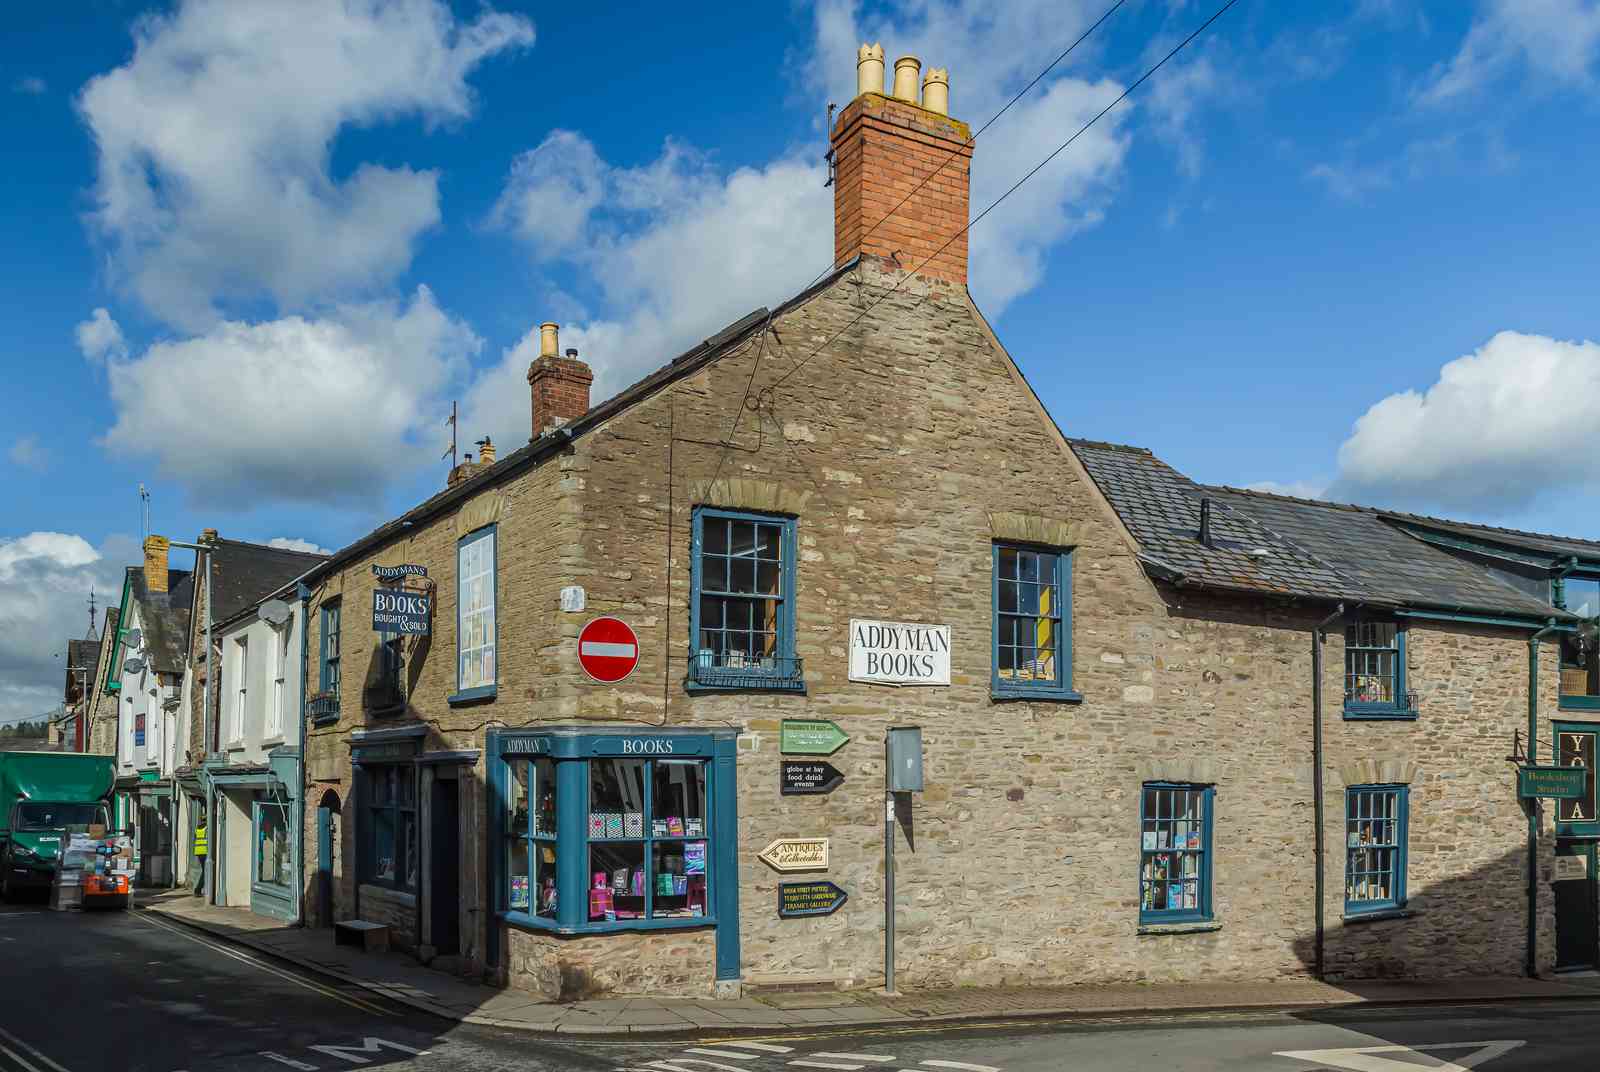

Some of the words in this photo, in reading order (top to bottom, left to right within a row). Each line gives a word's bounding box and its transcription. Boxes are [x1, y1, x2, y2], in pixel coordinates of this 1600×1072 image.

[375, 566, 425, 576] ADDYMANS
[375, 594, 427, 615] BOOKS
[374, 613, 401, 624] BOUGHT
[400, 615, 411, 632] &
[409, 621, 427, 631] SOLD
[854, 625, 948, 653] ADDYMAN
[867, 652, 934, 677] BOOKS
[507, 739, 540, 752] ADDYMAN
[623, 740, 673, 754] BOOKS
[1571, 735, 1585, 819] YOA
[781, 844, 824, 853] ANTIQUES
